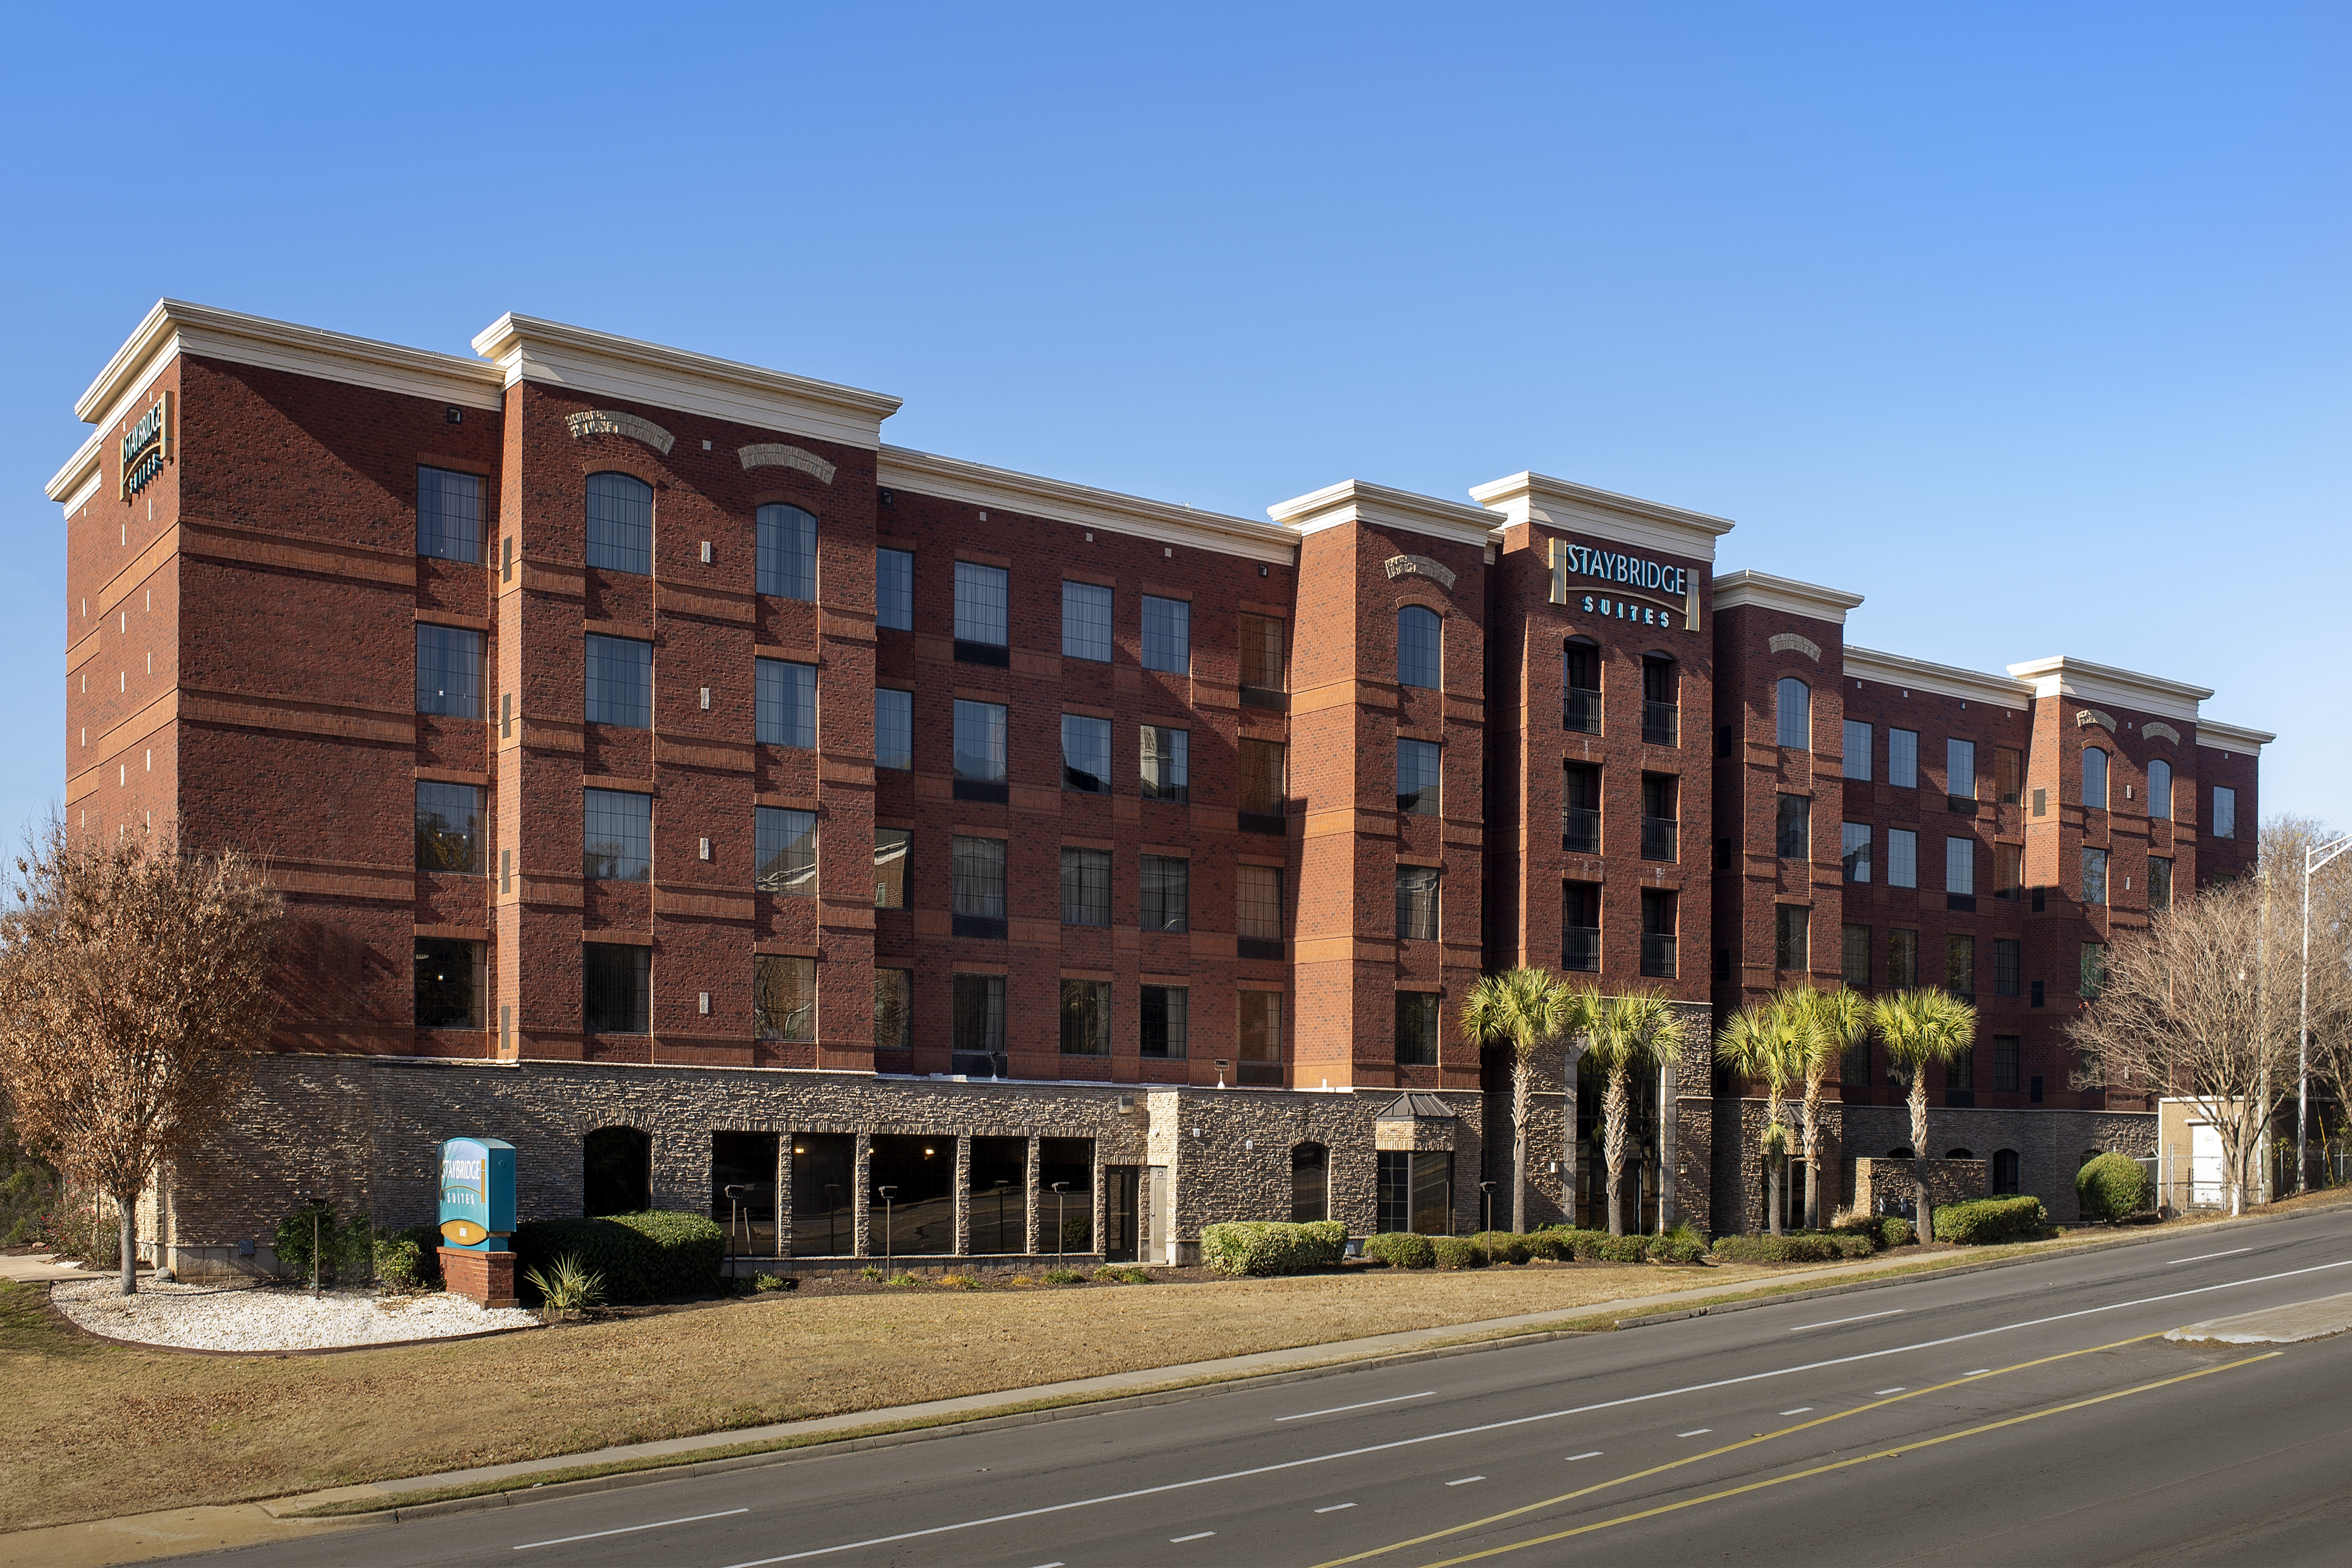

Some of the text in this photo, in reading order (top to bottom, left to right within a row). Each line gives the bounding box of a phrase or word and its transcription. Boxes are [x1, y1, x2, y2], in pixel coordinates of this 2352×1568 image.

[124, 398, 161, 463] STAYBRIDGE
[130, 453, 157, 493] SUITES
[1566, 544, 1685, 595] STAYBRIDGE
[1583, 596, 1669, 628] SUITES
[442, 1160, 480, 1179] STAYBRIDGE
[447, 1192, 474, 1205] SUITES
